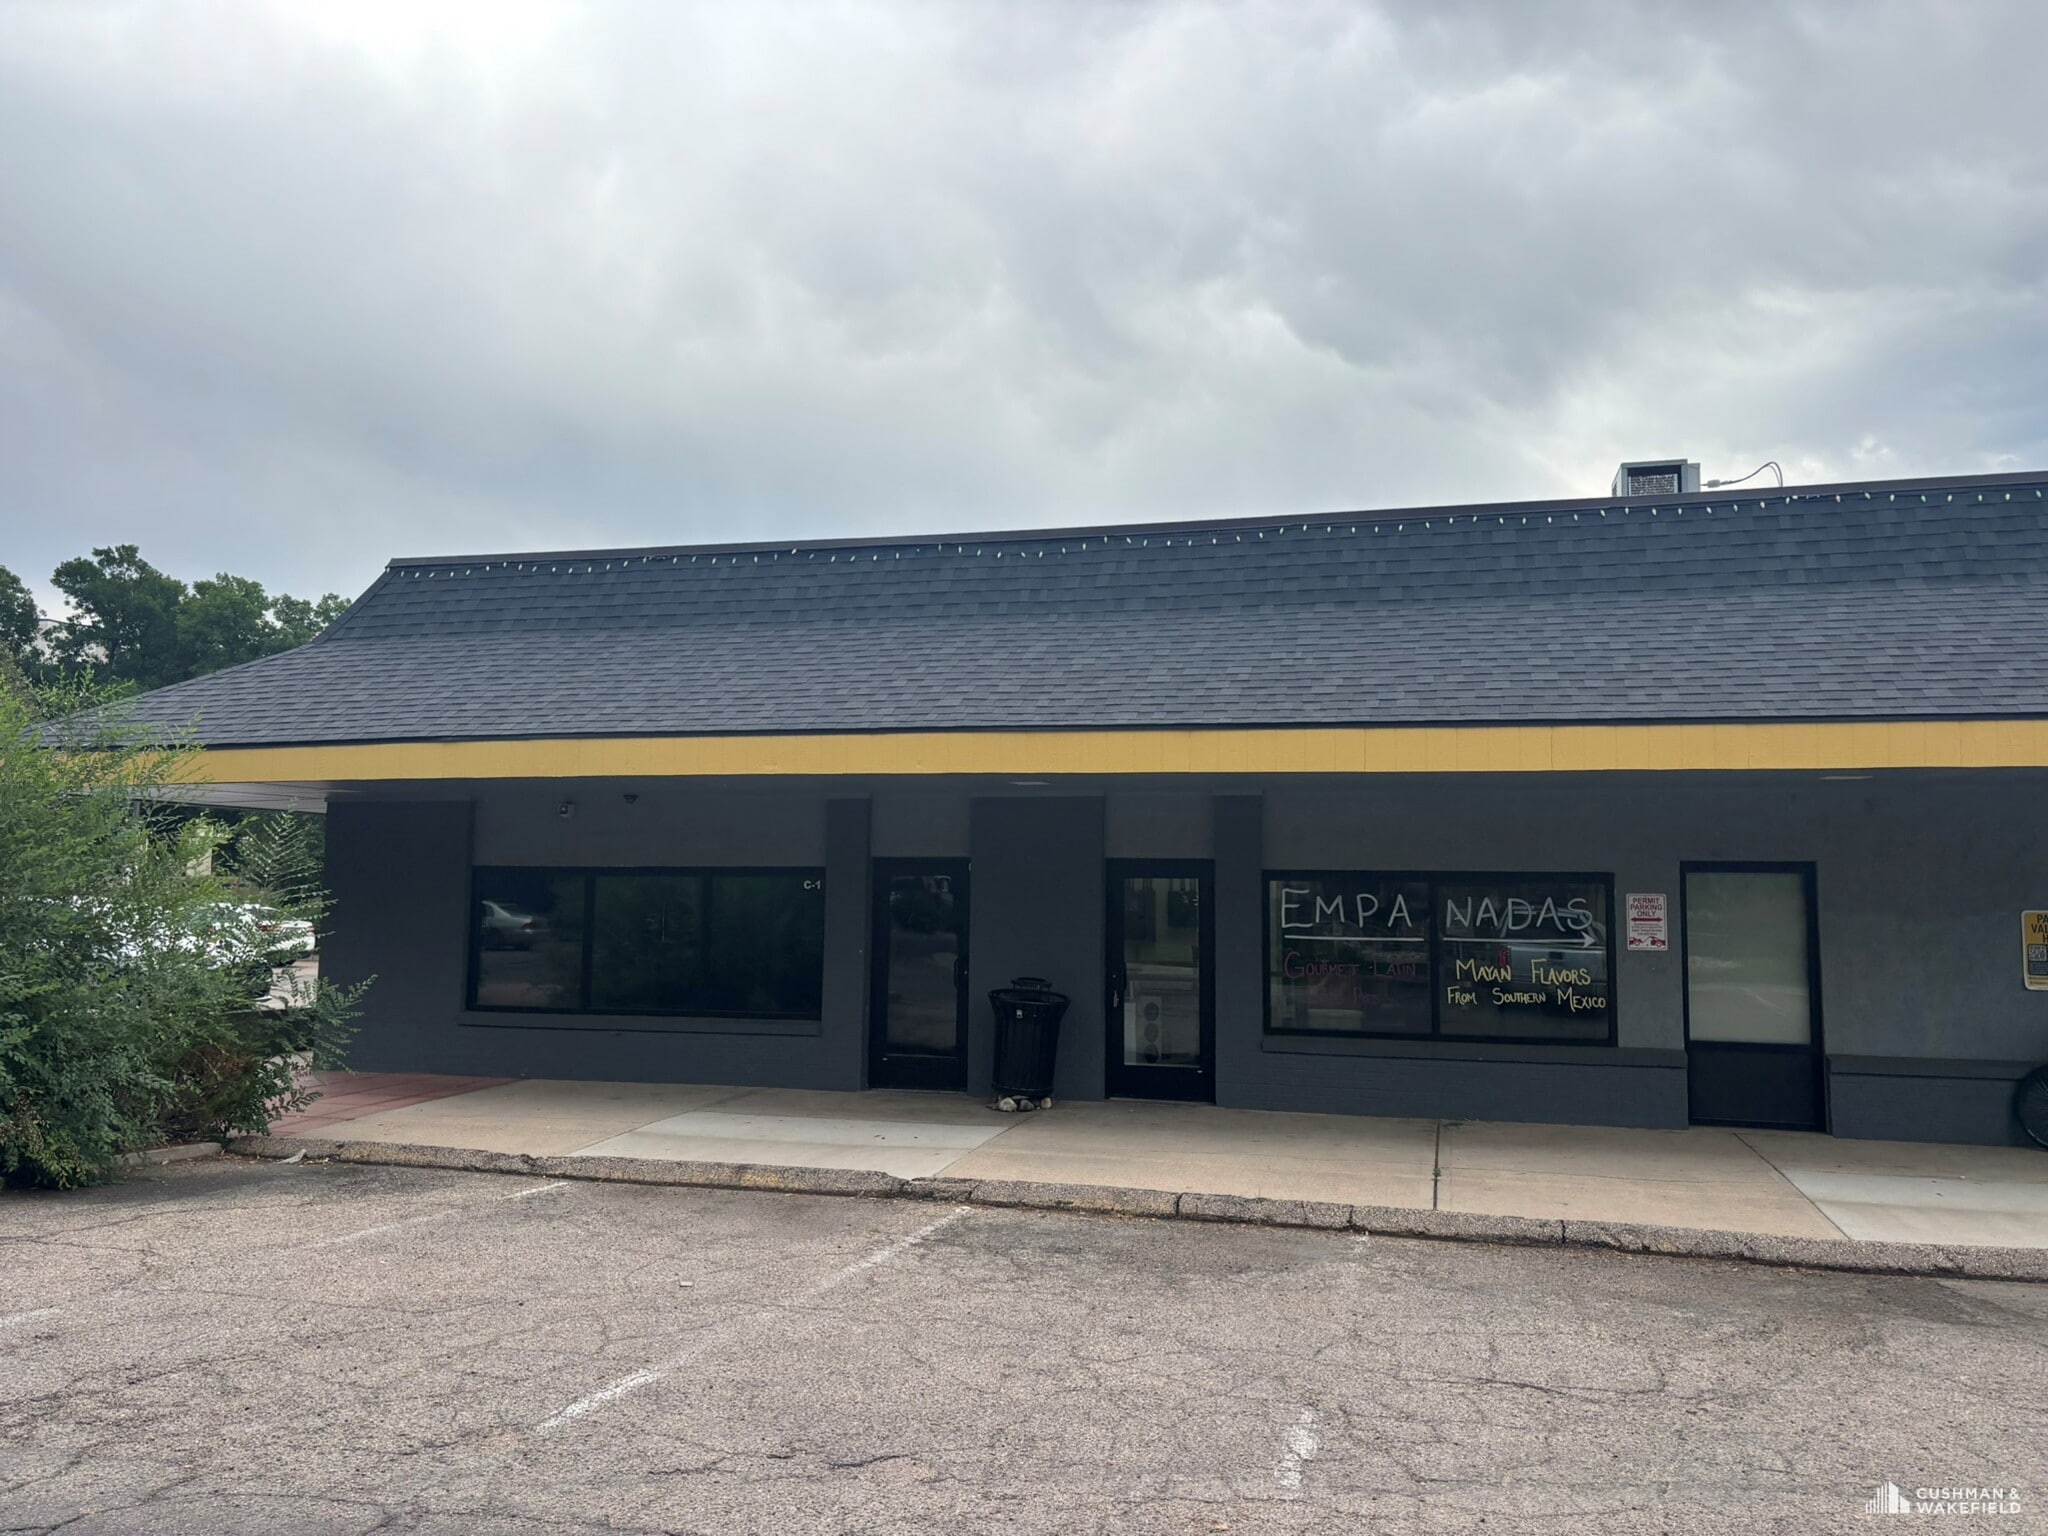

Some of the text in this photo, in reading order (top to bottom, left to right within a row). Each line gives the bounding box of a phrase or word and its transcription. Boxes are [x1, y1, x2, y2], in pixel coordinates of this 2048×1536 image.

[803, 880, 821, 890] C-1
[1281, 888, 1593, 932] EMPA NADAS
[1284, 951, 1416, 979] GOURMET LATIN
[1456, 958, 1592, 986] MAYAN FLAVORS
[1447, 986, 1607, 1013] FROM SOUTHERN MEXICO
